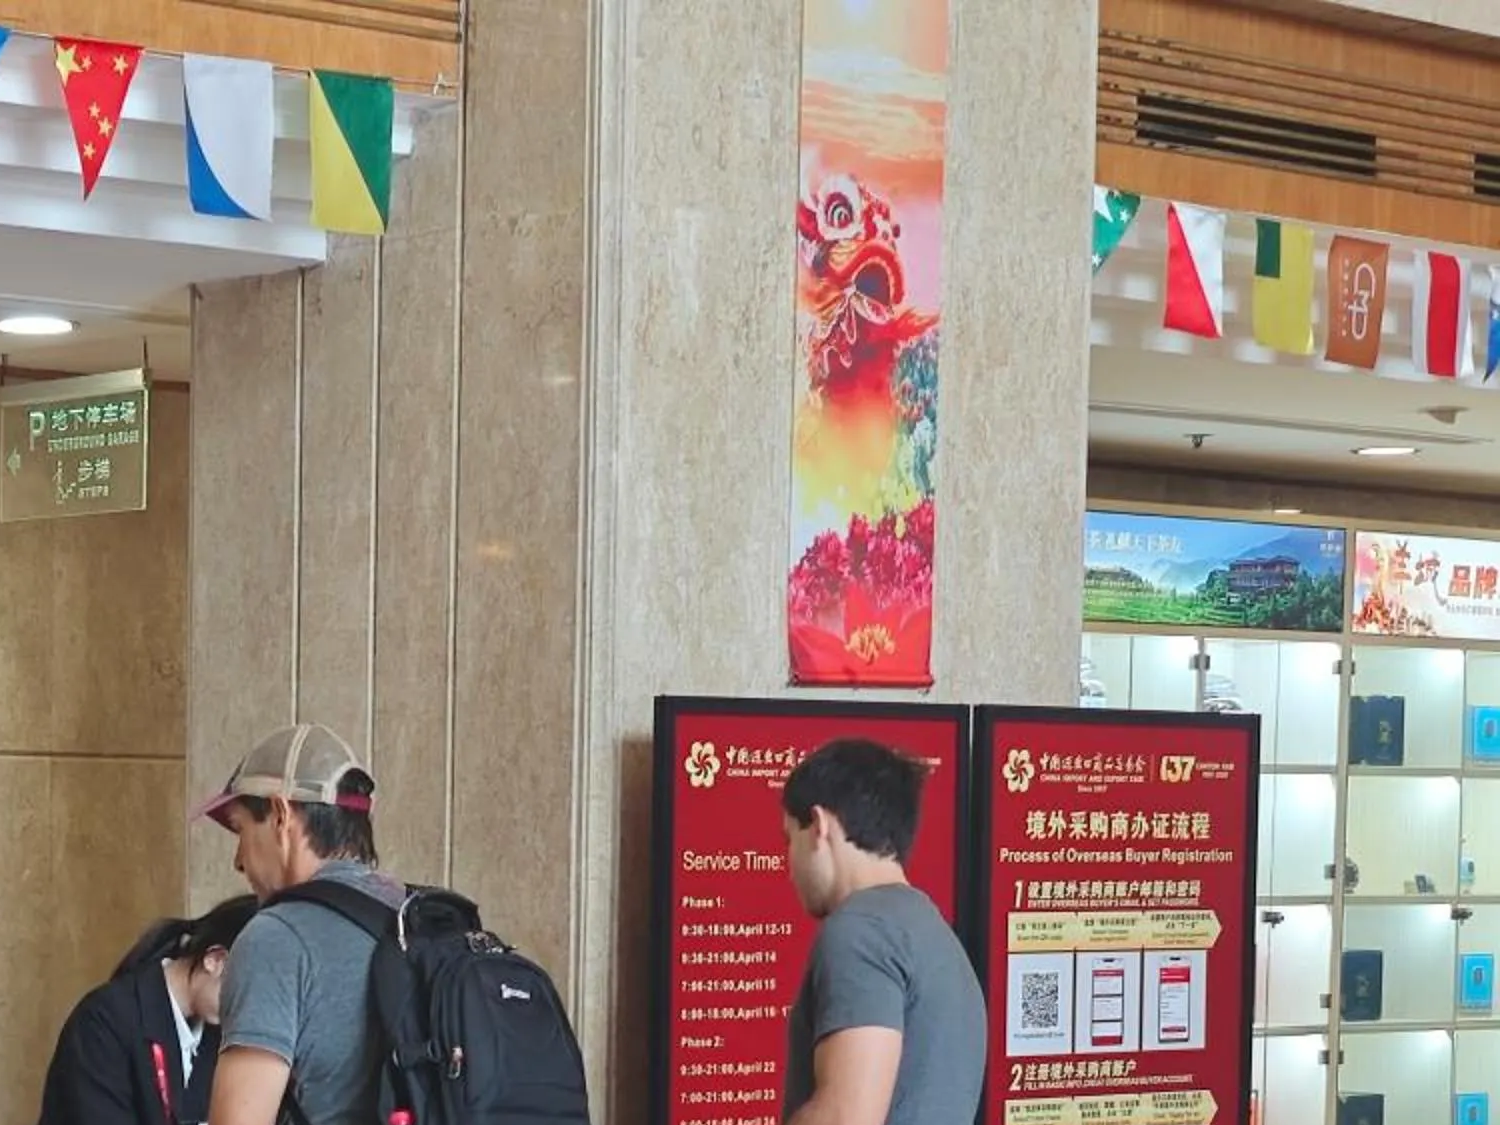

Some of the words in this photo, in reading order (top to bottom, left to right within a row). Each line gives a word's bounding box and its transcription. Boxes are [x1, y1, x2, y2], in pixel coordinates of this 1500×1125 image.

[1026, 810, 1211, 840] 境外采购商办证流程
[683, 850, 741, 871] Service
[743, 851, 785, 871] Time:
[1000, 848, 1050, 864] Process
[1052, 847, 1066, 863] of
[1066, 848, 1123, 863] Overseas
[1125, 847, 1160, 866] Buyer
[1161, 848, 1234, 866] Registration
[682, 896, 714, 908] Phase
[1014, 880, 1024, 909] 1
[681, 1037, 711, 1049] Phase
[1009, 1063, 1023, 1092] 2
